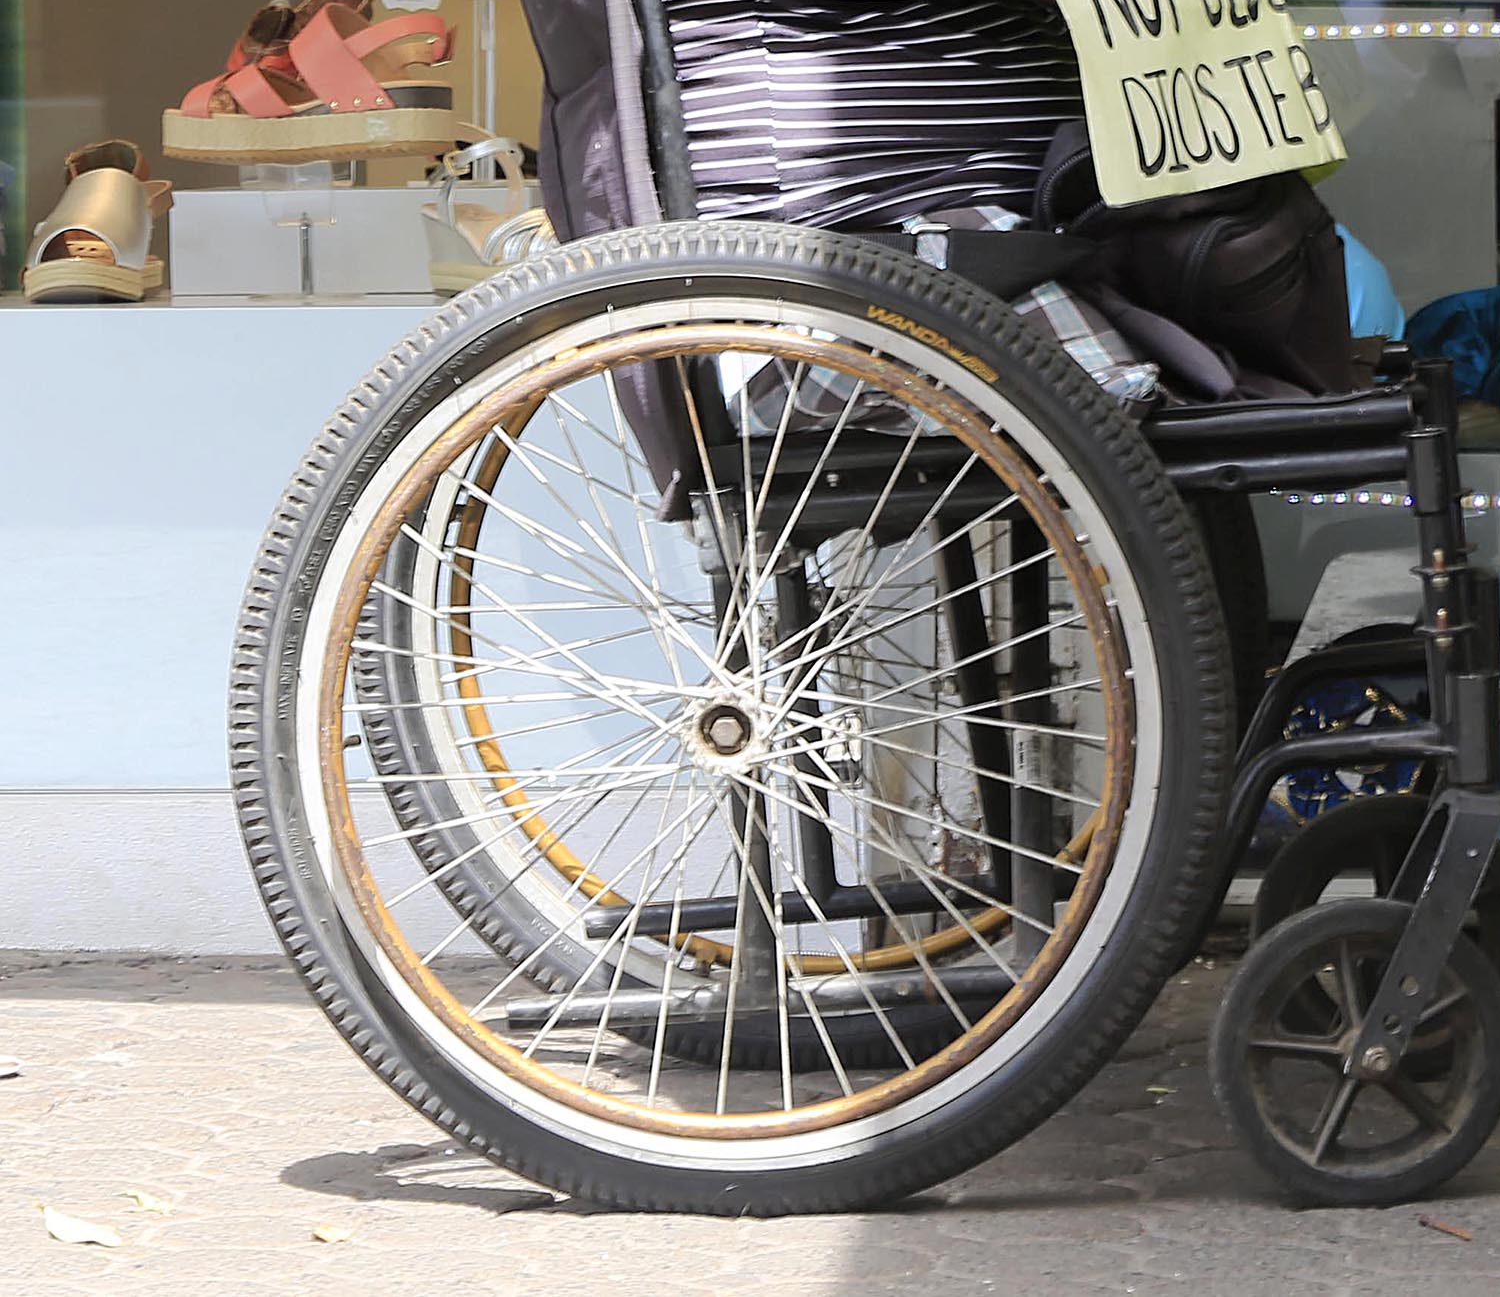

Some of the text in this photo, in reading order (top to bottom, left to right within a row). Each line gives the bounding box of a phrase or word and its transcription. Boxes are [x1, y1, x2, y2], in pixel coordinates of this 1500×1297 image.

[1121, 63, 1240, 178] DIOS
[1223, 49, 1304, 148] TE
[867, 304, 951, 350] WANDA
